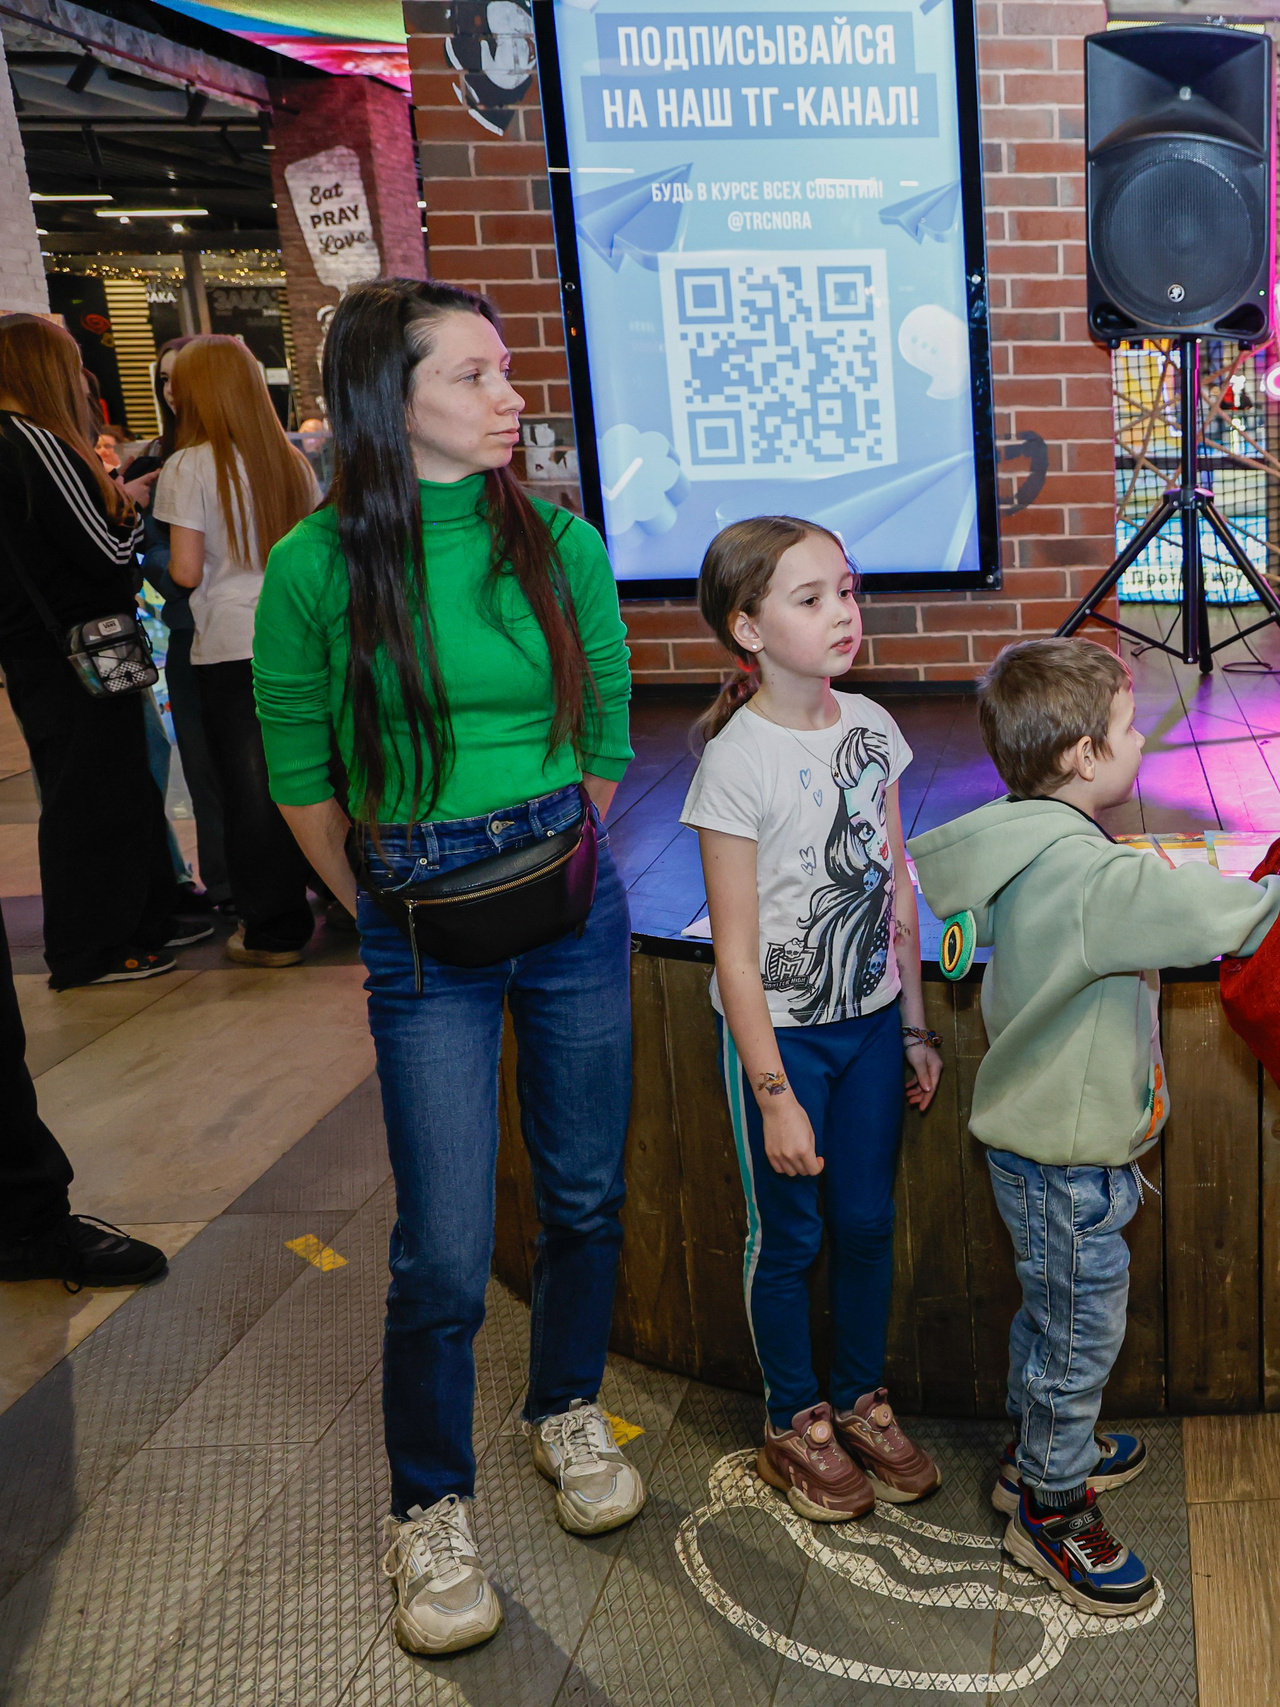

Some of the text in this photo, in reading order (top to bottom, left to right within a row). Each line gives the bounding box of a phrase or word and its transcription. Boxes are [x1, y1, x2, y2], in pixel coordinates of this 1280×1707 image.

[617, 16, 896, 71] ПОДПИСЫВАЙСЯ
[602, 85, 920, 129] НА НАШ ТГ-КАНАЛ!
[309, 182, 344, 206] Eat
[651, 177, 884, 204] БУДЬ В КУРСЕ ВСЕХ СОБЫТИЙ!
[310, 204, 360, 229] PRAY
[727, 210, 813, 232] @TRCNORA
[318, 230, 369, 255] Love
